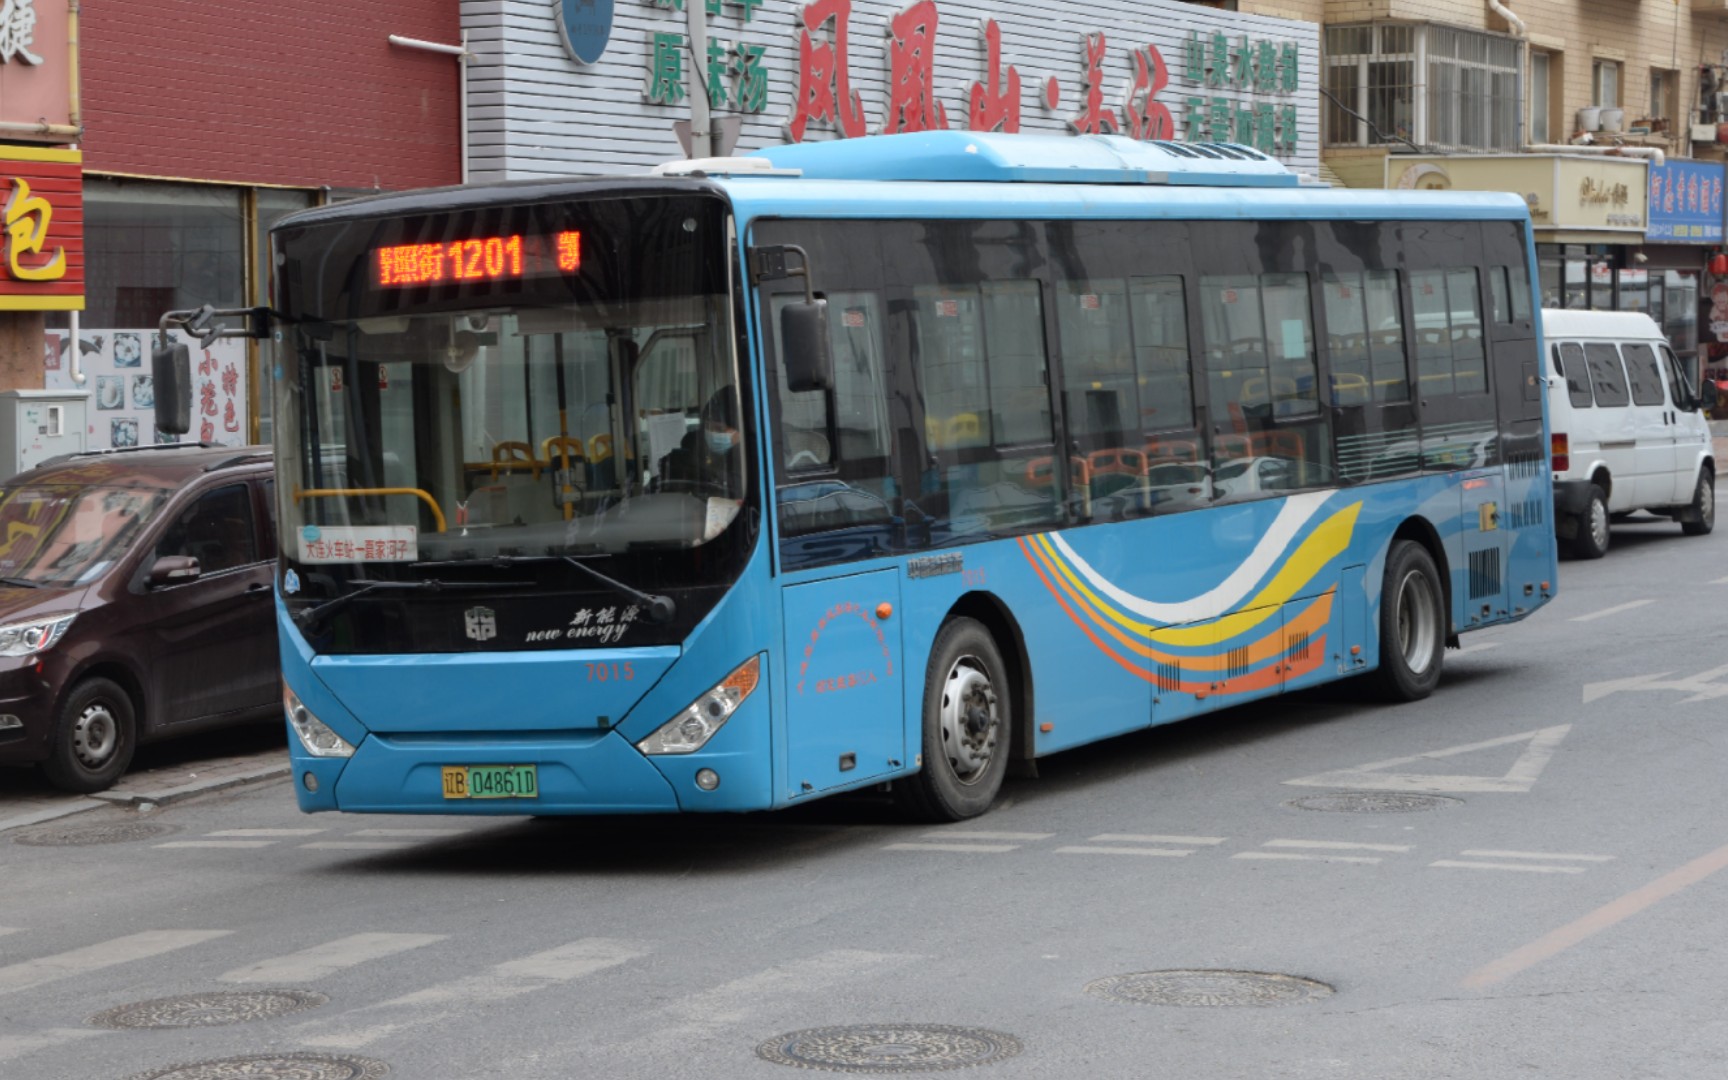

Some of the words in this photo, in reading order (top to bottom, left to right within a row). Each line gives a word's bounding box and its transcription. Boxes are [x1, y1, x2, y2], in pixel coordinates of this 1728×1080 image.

[7, 177, 66, 281] 包
[448, 234, 522, 279] 1201
[222, 363, 239, 432] 特色
[569, 605, 640, 626] 新能源
[525, 628, 562, 642] new
[566, 623, 629, 643] energy
[585, 662, 635, 682] 7015
[472, 770, 534, 793] 04861D
